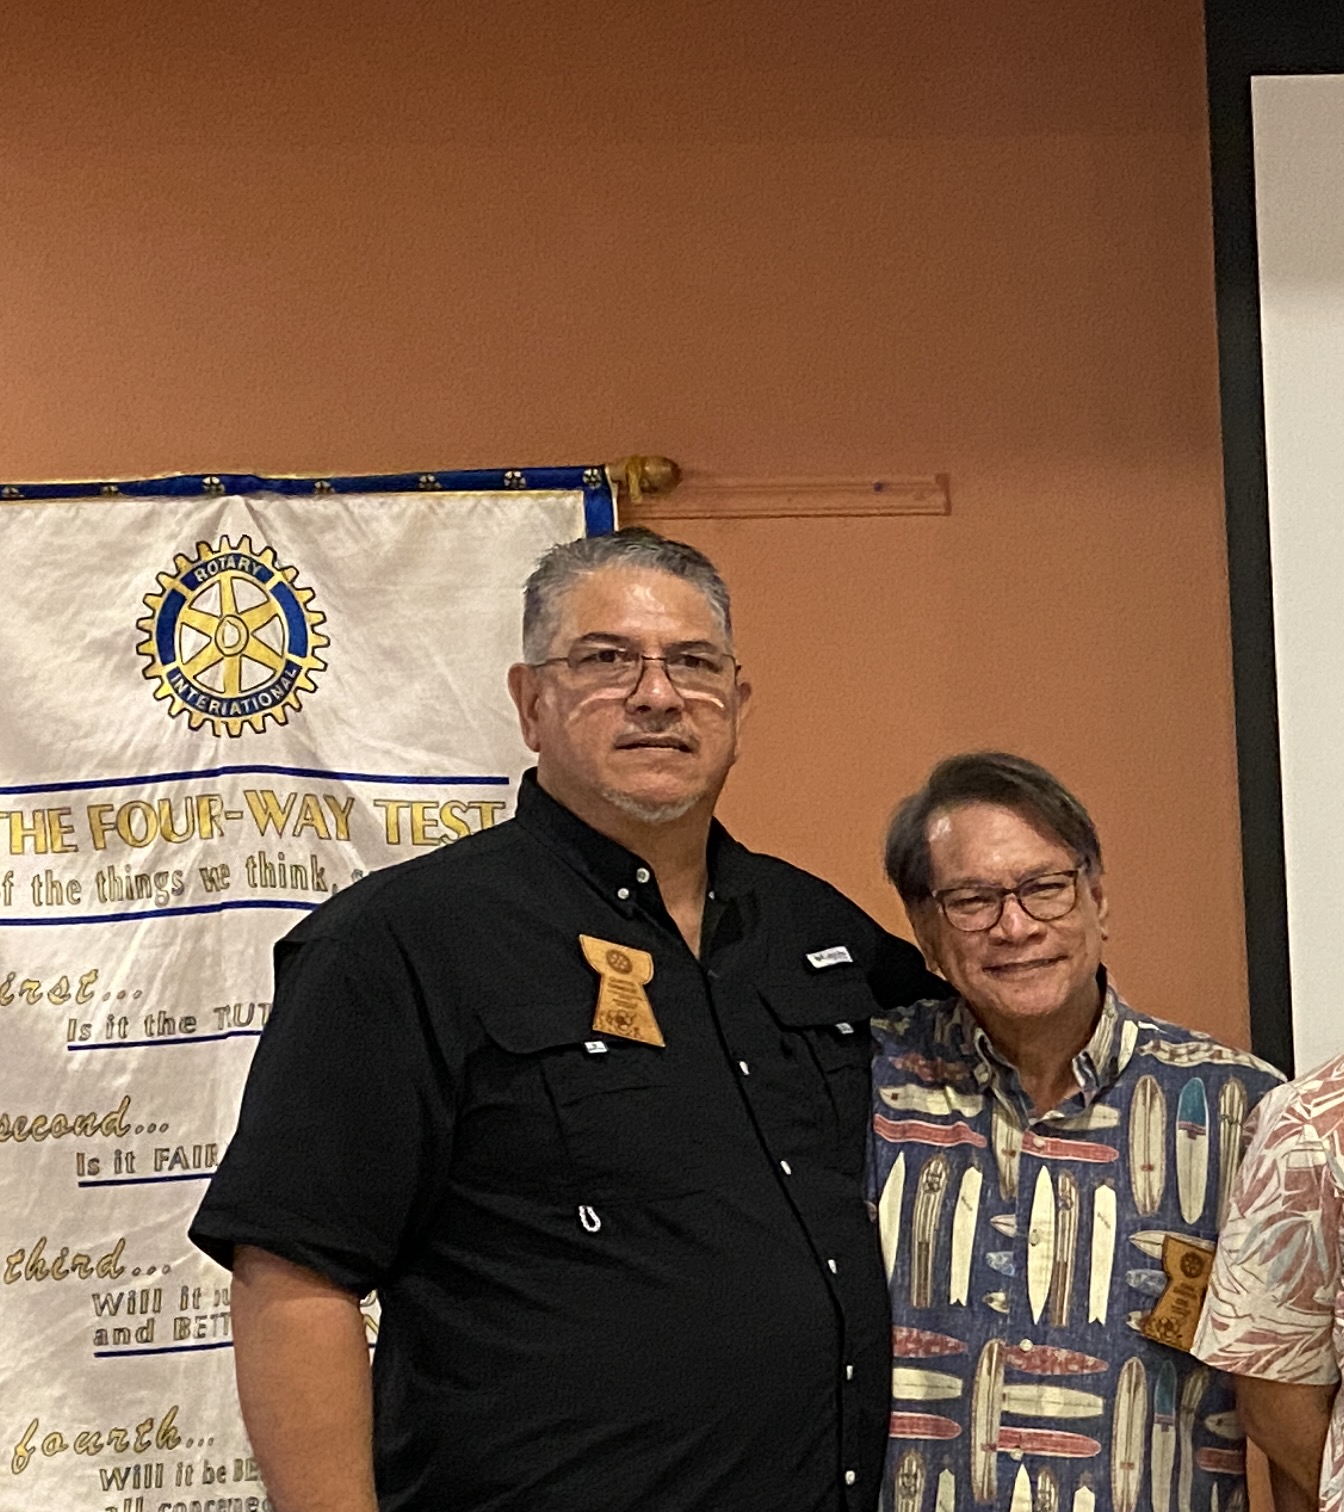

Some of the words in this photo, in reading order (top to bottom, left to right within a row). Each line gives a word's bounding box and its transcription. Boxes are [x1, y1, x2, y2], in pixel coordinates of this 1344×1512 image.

[193, 556, 262, 582] ROTARY
[87, 789, 355, 850] FOUR-WAY
[373, 799, 506, 846] TEST
[0, 870, 14, 906] f
[31, 869, 82, 907] the
[95, 863, 186, 908] things
[0, 969, 143, 1006] irst...
[67, 1018, 92, 1042] Is
[105, 1013, 130, 1040] it
[144, 1010, 197, 1037] the
[76, 1152, 101, 1177] Is
[113, 1148, 136, 1175] it
[92, 1286, 163, 1317] Will
[180, 1284, 202, 1311] it
[93, 1316, 156, 1347] and
[173, 1311, 232, 1342] BETT
[99, 1462, 164, 1492] Will
[175, 1461, 195, 1488] it
[201, 1458, 228, 1486] be
